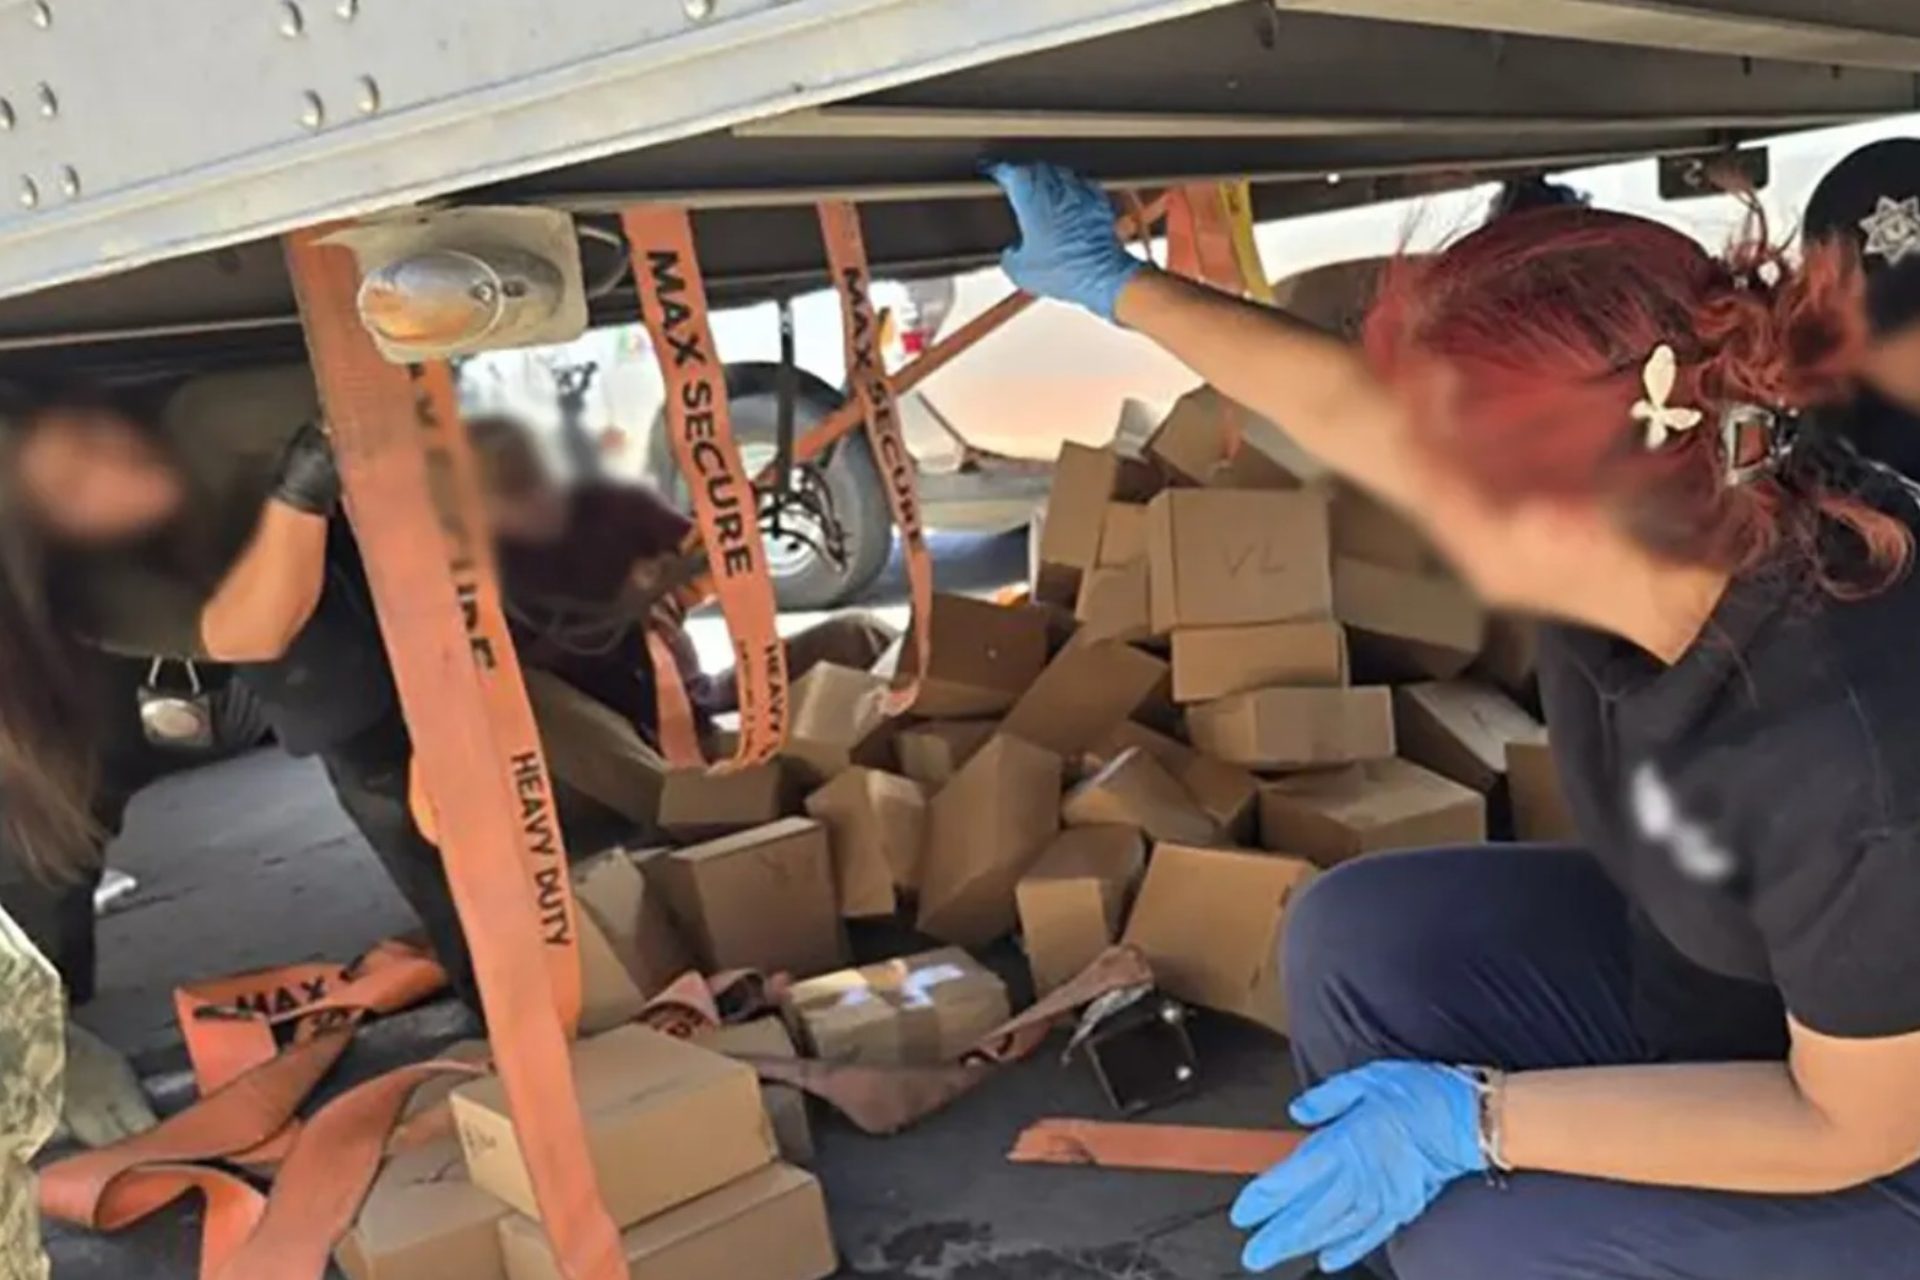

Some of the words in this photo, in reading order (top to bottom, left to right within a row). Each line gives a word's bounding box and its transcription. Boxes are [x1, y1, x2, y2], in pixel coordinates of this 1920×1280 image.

[647, 250, 705, 364] MAX
[682, 381, 753, 577] SECURE
[843, 267, 875, 368] MAX
[510, 751, 557, 859] HEAVY
[535, 866, 574, 948] DUTY
